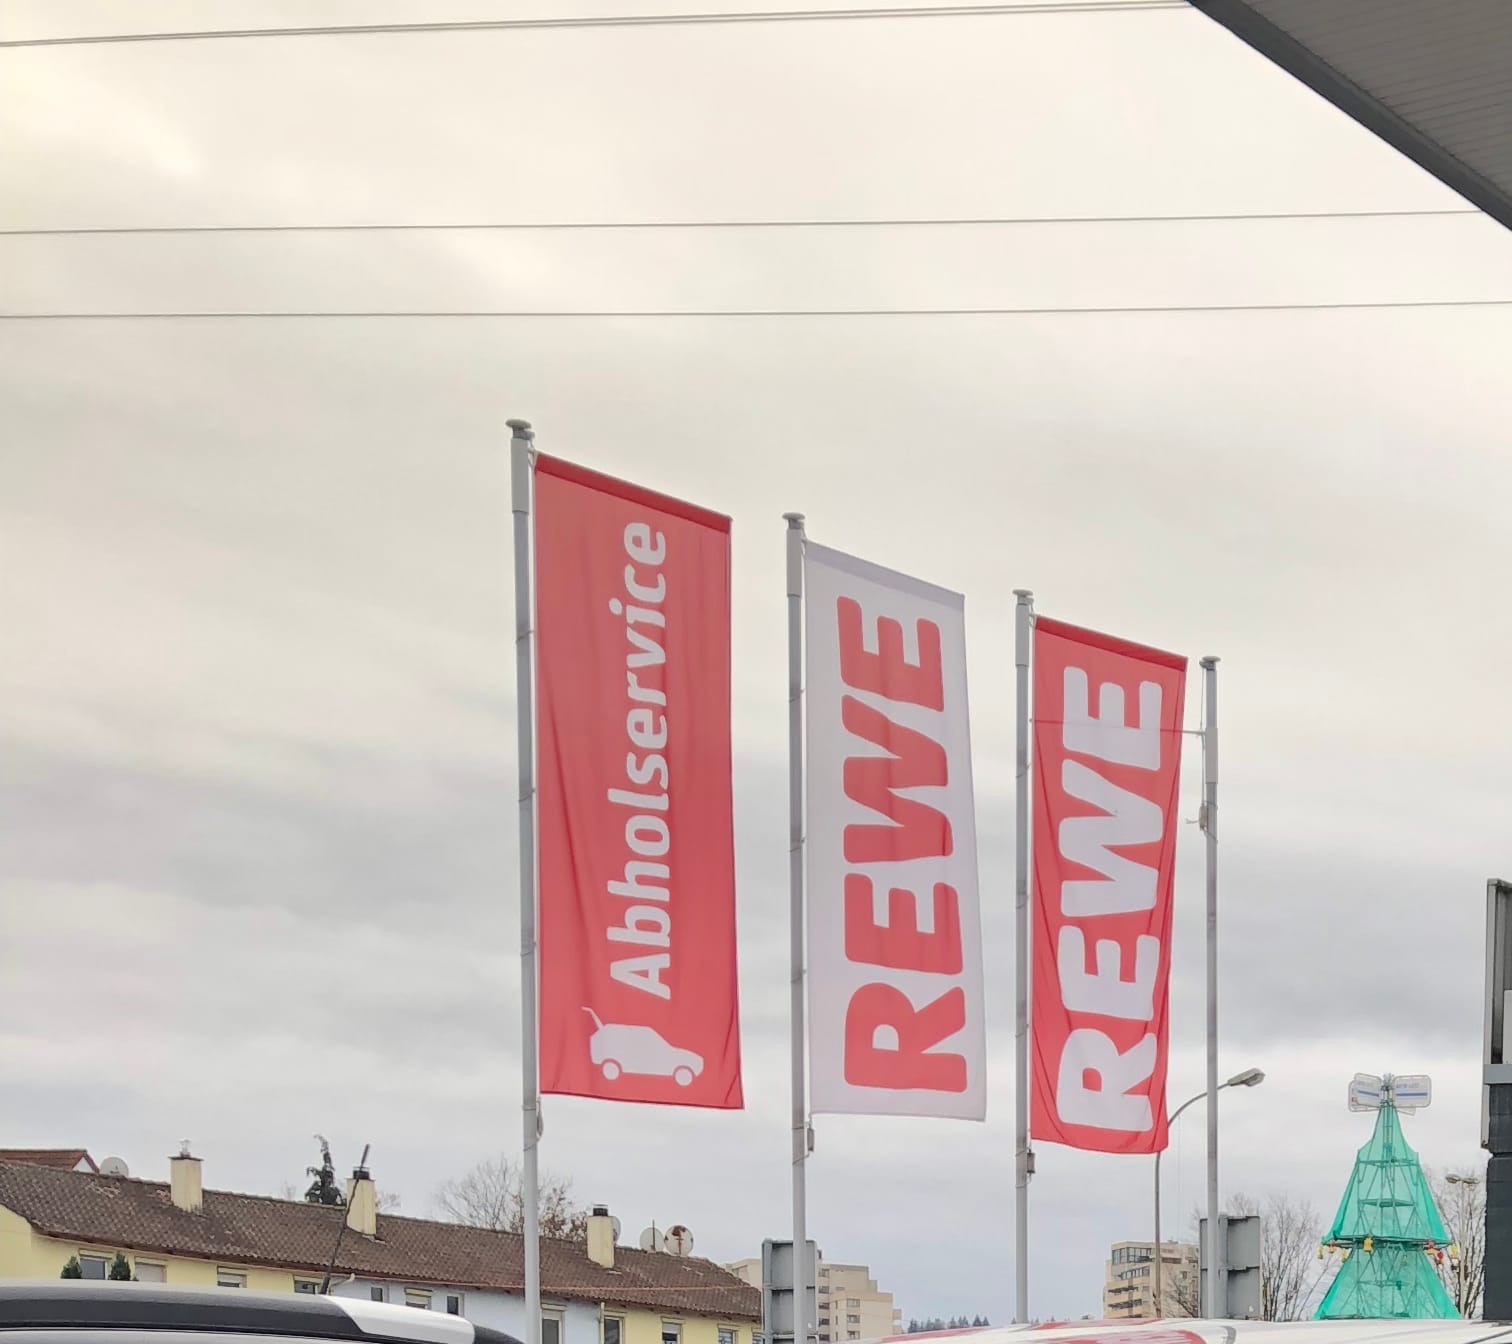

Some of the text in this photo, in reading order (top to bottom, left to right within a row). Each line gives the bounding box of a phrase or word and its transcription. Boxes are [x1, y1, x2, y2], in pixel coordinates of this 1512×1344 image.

[606, 521, 671, 1000] Abholservice
[837, 595, 968, 1093] REWE
[1055, 665, 1163, 1132] REWE
